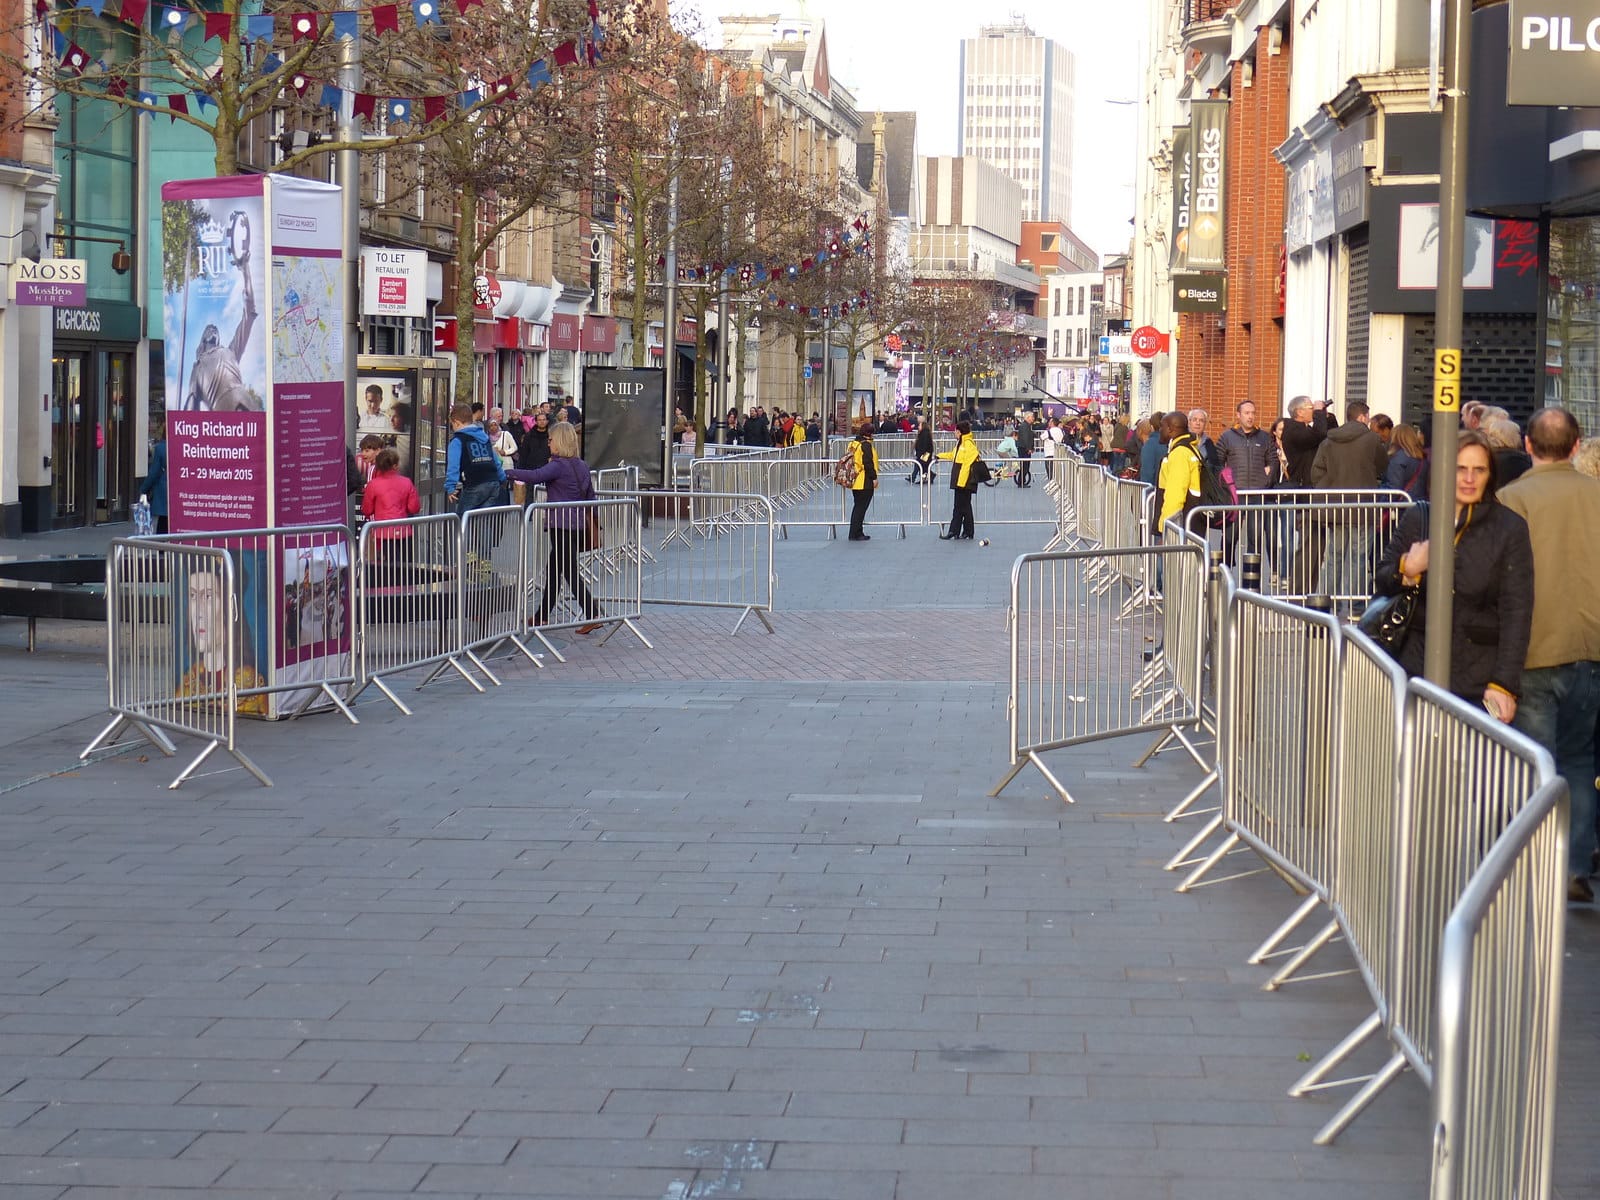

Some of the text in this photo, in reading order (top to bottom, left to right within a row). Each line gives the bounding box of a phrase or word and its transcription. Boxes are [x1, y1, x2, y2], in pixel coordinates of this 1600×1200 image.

[1196, 128, 1220, 212] Blacks
[376, 253, 405, 263] TO LET
[20, 264, 81, 280] MOSS
[376, 266, 410, 275] RETAIL UNIT
[381, 279, 403, 287] Lambert
[381, 286, 397, 294] Smith
[381, 292, 404, 301] Hampton
[1187, 289, 1217, 299] Blacks
[56, 308, 101, 332] HIGHCROSS
[1440, 353, 1456, 375] S
[604, 382, 644, 395] R III P
[1440, 386, 1454, 406] 5
[174, 420, 257, 439] King Richard III
[182, 443, 250, 460] Reinterment
[180, 467, 189, 478] 21
[196, 468, 208, 479] 29
[209, 468, 233, 480] March
[234, 469, 253, 481] 2015
